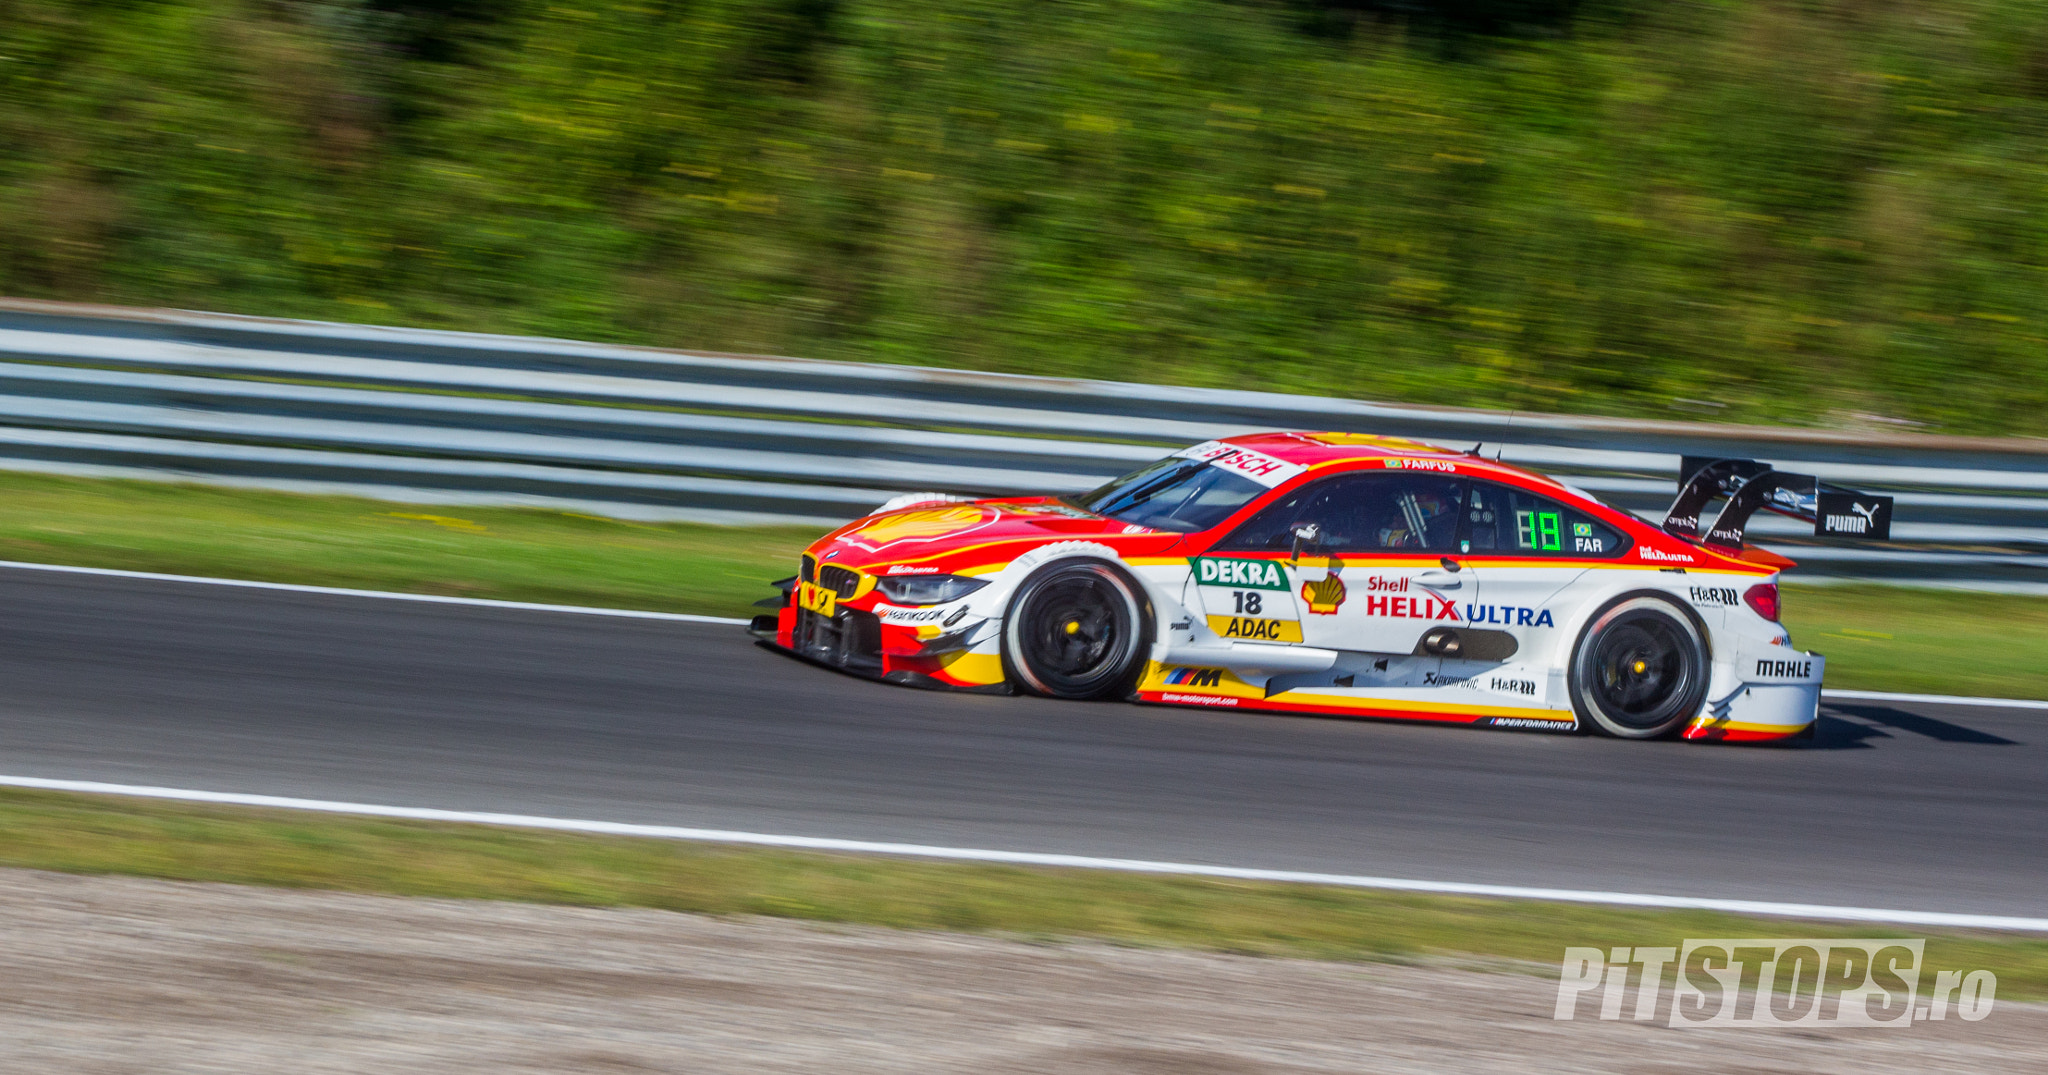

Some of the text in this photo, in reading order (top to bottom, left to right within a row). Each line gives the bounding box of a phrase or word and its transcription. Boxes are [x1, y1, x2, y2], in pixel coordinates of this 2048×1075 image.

[1403, 459, 1456, 473] FARFUS
[1825, 514, 1867, 534] PUMA
[1575, 537, 1603, 553] FAR
[1200, 559, 1281, 587] DEKRA
[1367, 575, 1409, 593] Shell
[1232, 591, 1263, 616] 18
[1690, 586, 1721, 603] H&R
[1366, 594, 1555, 628] HELIX ULTRA
[1224, 617, 1281, 640] ADAC
[1756, 659, 1812, 678] MAHLE
[1491, 677, 1521, 693] H&R
